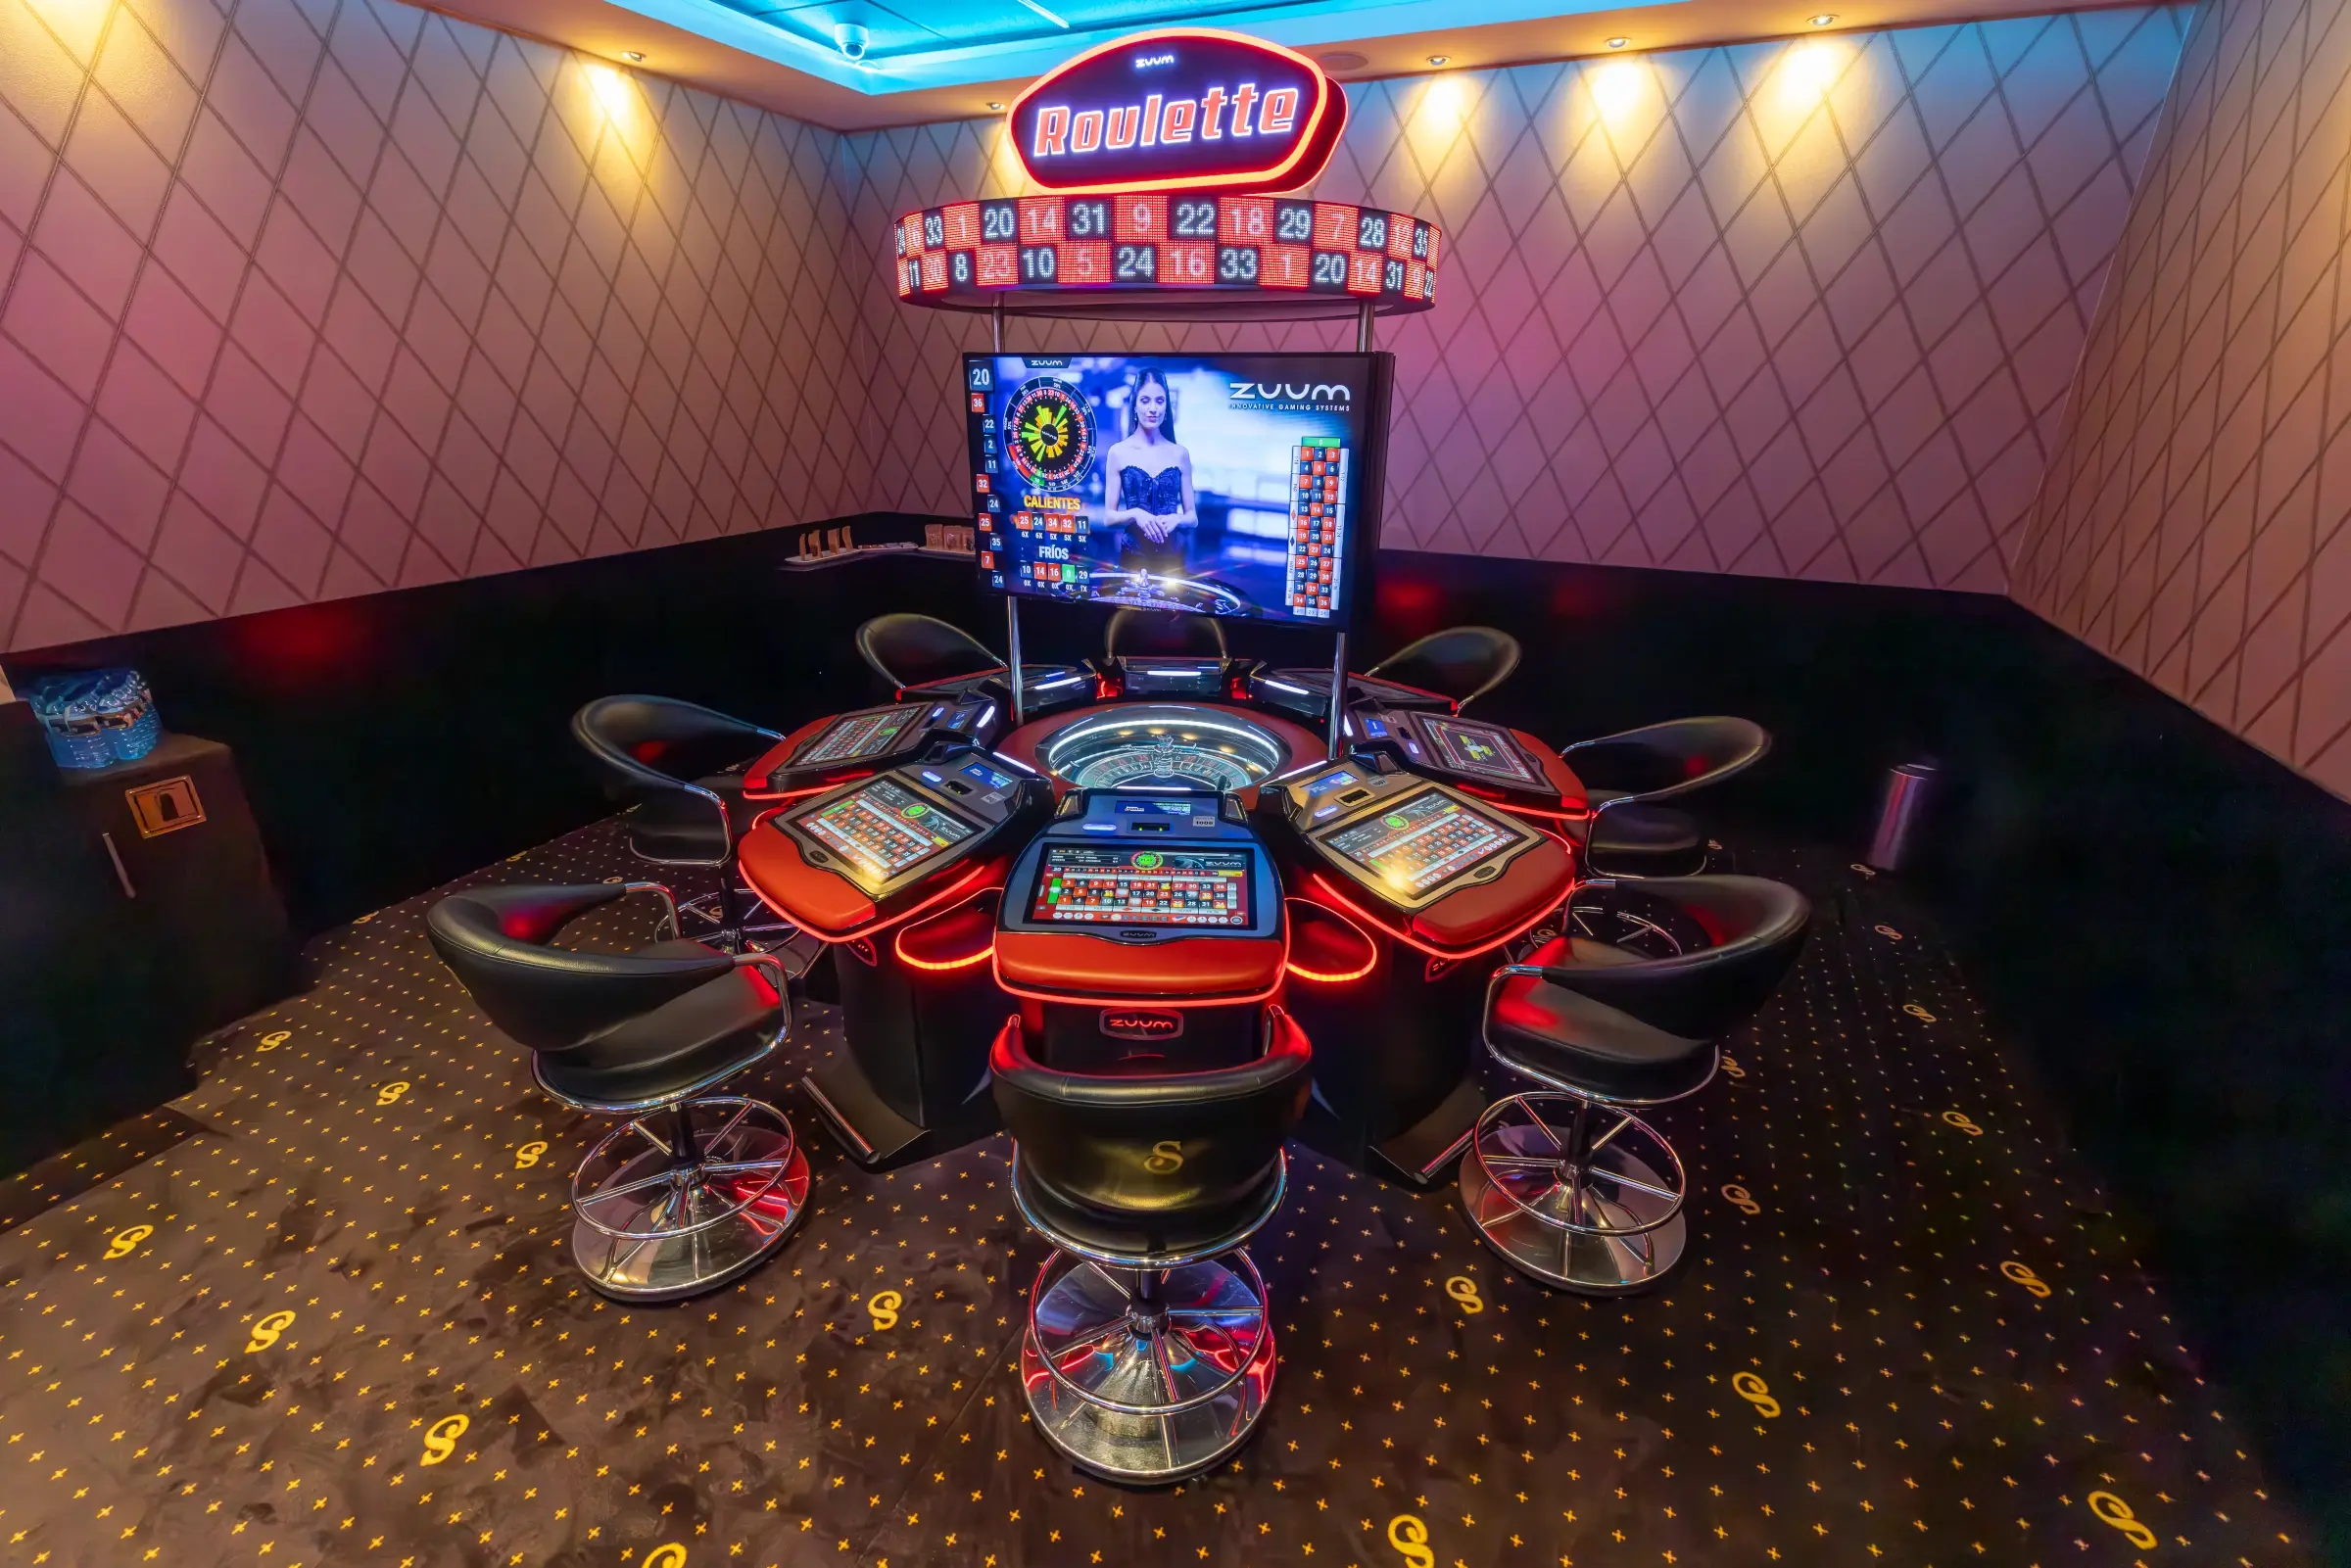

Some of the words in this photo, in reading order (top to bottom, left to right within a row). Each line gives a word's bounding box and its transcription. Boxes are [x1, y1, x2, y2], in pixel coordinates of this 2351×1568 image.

[1033, 83, 1299, 157] Roulette
[926, 216, 943, 245] 33
[958, 215, 965, 239] 1
[984, 207, 1015, 239] 20
[1028, 206, 1057, 234] 14
[1073, 204, 1104, 235] 31
[1134, 203, 1151, 232] 9
[1177, 204, 1215, 235] 22
[1231, 207, 1264, 235] 18
[1279, 208, 1311, 240] 29
[1332, 213, 1345, 239] 7
[1360, 217, 1385, 248] 28
[1394, 225, 1410, 251] 12
[1414, 228, 1429, 257] 35
[909, 260, 920, 287] 11
[955, 253, 968, 282] 8
[983, 251, 1010, 279] 23
[1023, 248, 1055, 278] 10
[1078, 247, 1094, 275] 5
[1118, 247, 1154, 277] 24
[1170, 248, 1206, 277] 16
[1221, 248, 1258, 279] 33
[1282, 253, 1292, 280] 1
[1314, 254, 1346, 284] 20
[1357, 259, 1376, 285] 14
[1386, 261, 1403, 290] 31
[972, 368, 990, 385] 20
[973, 398, 982, 407] 36
[985, 420, 994, 428] 22
[988, 440, 993, 449] 2
[988, 460, 996, 469] 11
[979, 479, 987, 488] 32
[989, 499, 998, 508] 24
[1024, 495, 1081, 510] CALIENTES
[981, 518, 990, 527] 25
[1020, 516, 1029, 524] 25
[1034, 517, 1043, 525] 24
[1048, 518, 1057, 526] 34
[1063, 519, 1072, 528] 32
[1078, 521, 1086, 529] 11
[992, 538, 1001, 546] 35
[1039, 544, 1069, 560] FRÍOS
[985, 556, 990, 565] 7
[1022, 566, 1031, 574] 10
[1036, 567, 1045, 575] 14
[1050, 568, 1059, 576] 16
[1079, 571, 1088, 579] 29
[994, 575, 1003, 583] 24
